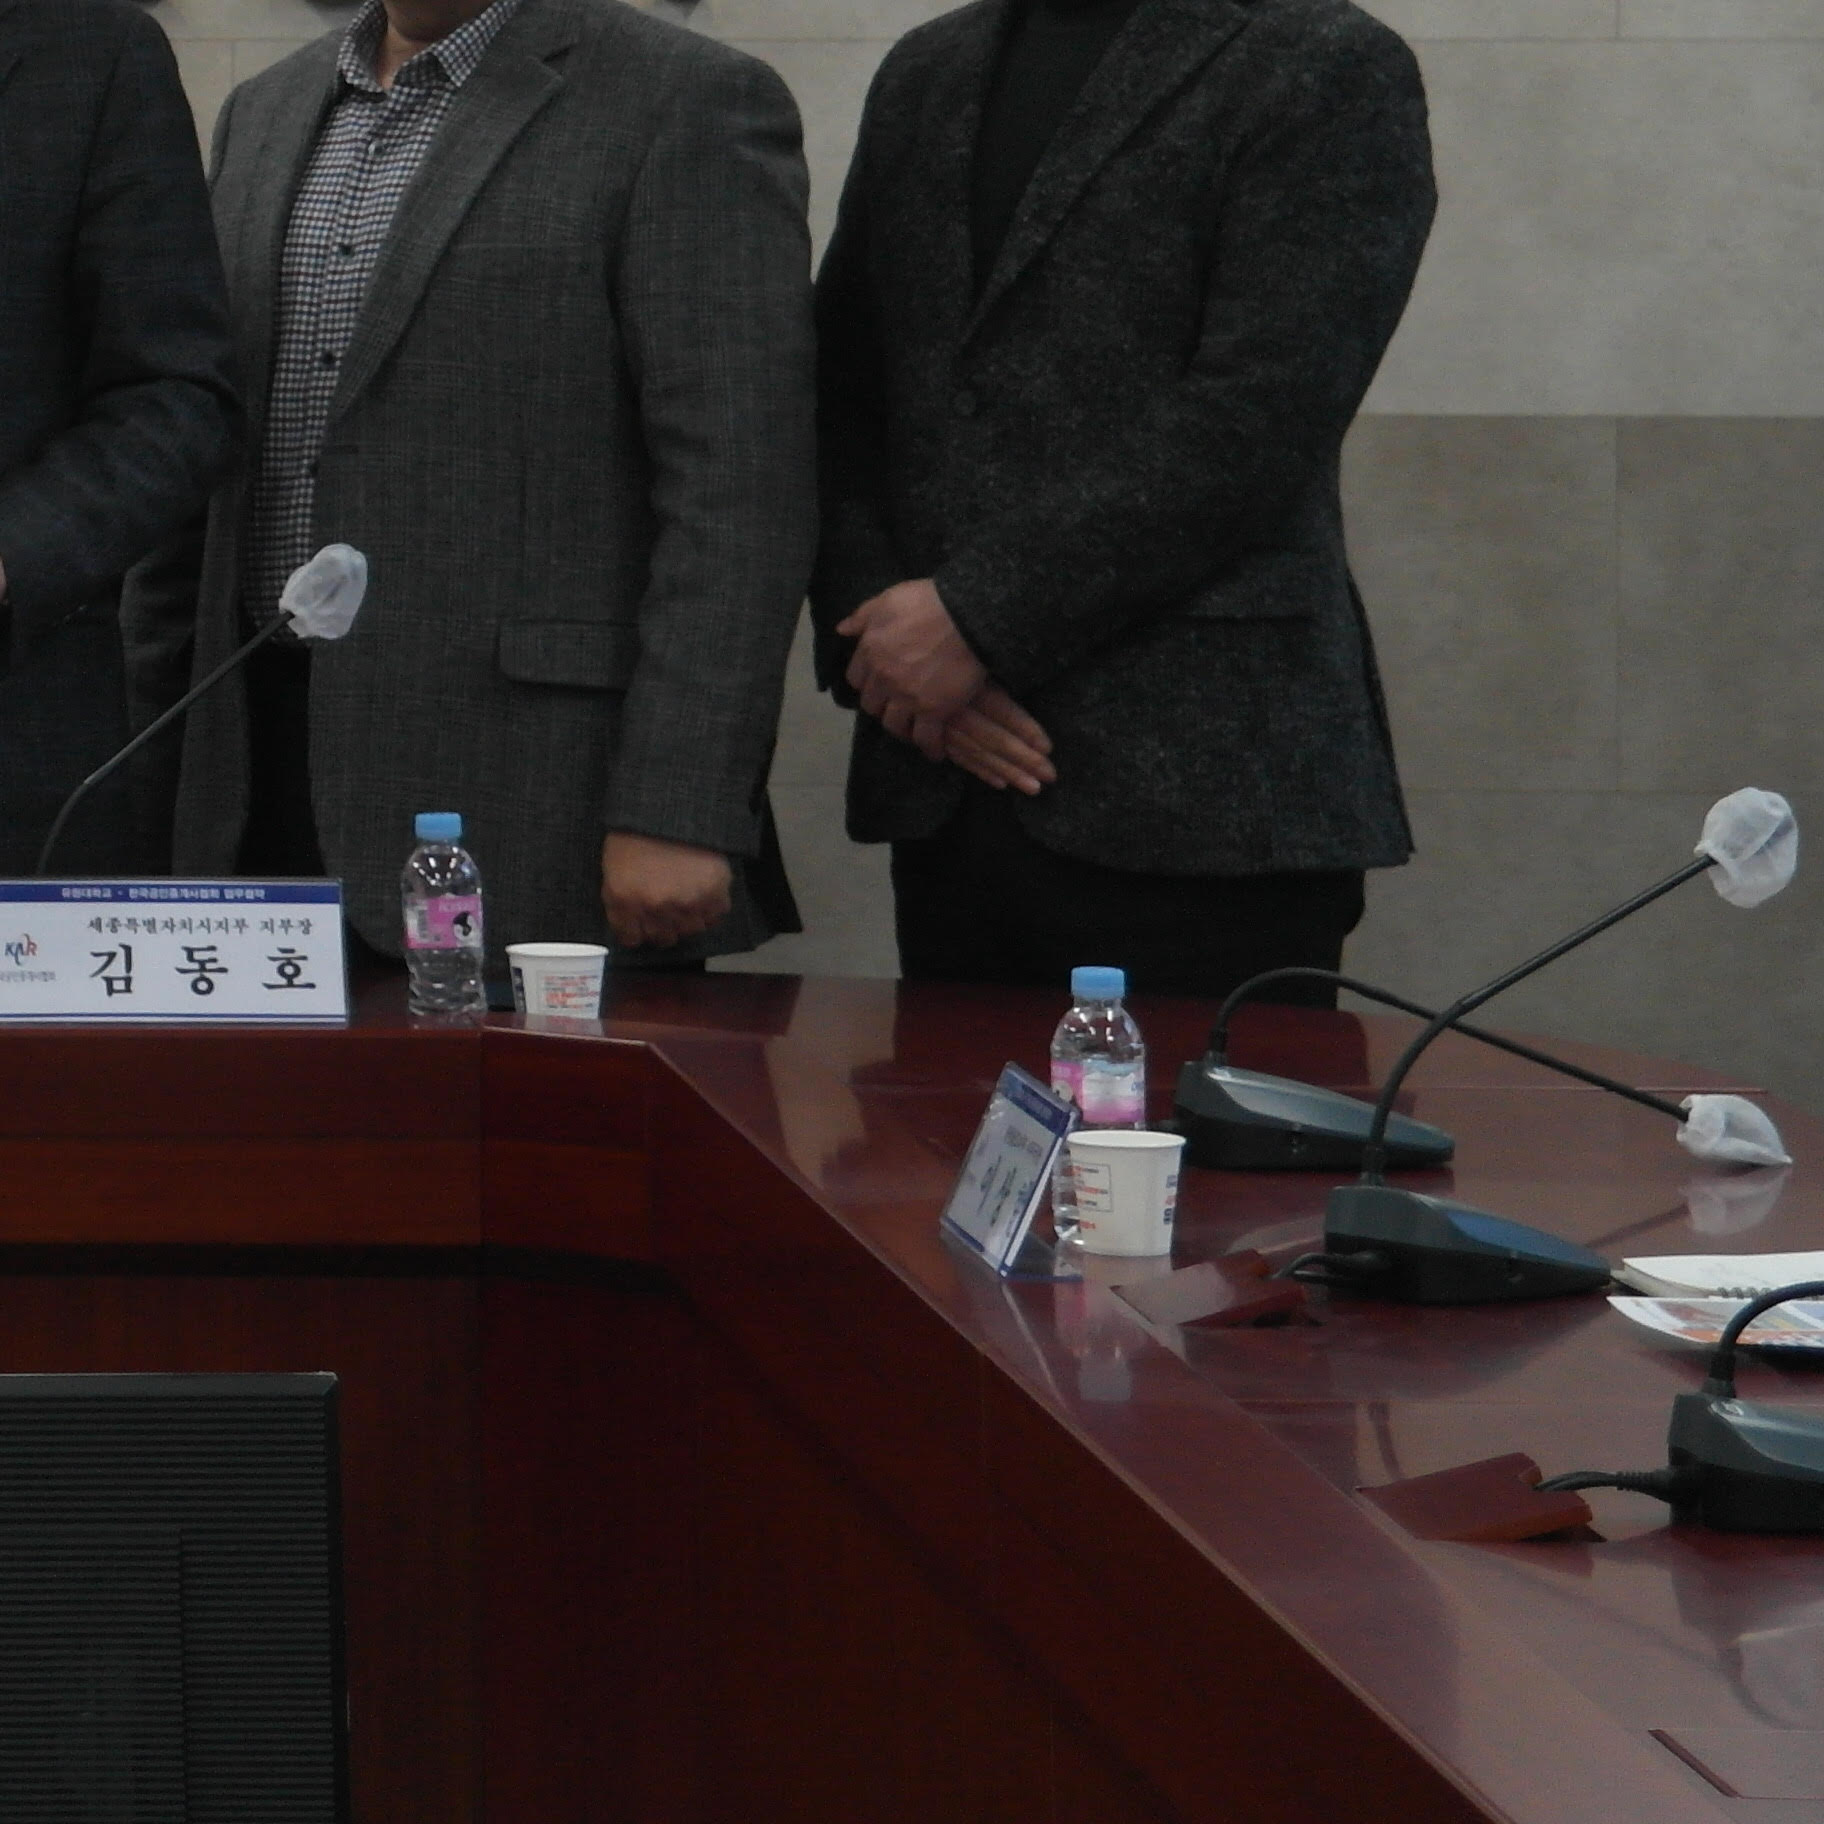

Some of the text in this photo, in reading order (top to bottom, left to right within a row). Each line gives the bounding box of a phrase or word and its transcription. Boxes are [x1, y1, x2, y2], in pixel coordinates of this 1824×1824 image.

[87, 916, 313, 936] 세종특별자치시지부 지부장
[89, 943, 317, 997] 김동호
